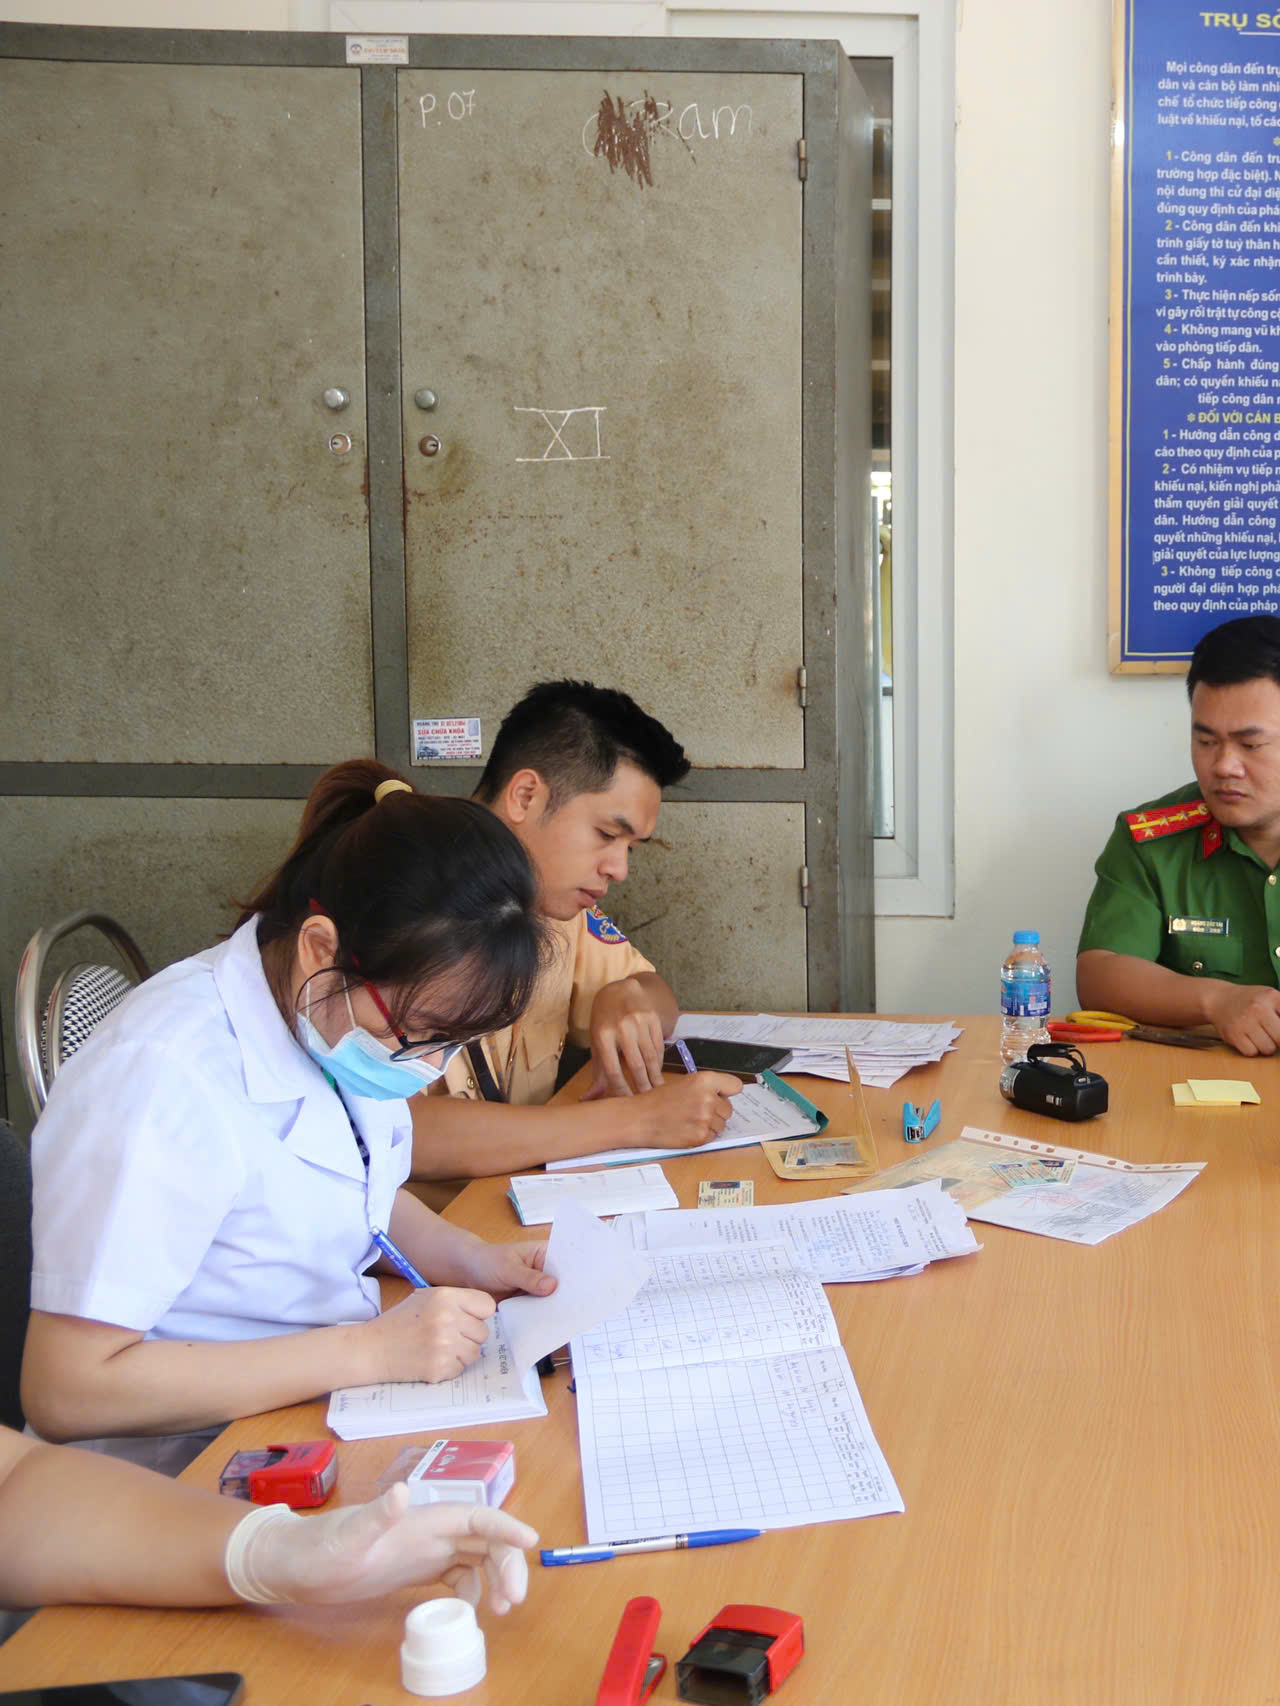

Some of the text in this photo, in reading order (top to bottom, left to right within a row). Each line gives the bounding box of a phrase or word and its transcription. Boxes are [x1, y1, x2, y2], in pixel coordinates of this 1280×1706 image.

[1200, 13, 1248, 31] TRỤ
[1166, 62, 1187, 75] Mọi
[1189, 62, 1218, 75] công
[1219, 62, 1241, 74] dân
[1243, 62, 1265, 75] đến
[1158, 78, 1179, 89] dân
[1221, 80, 1237, 93] bộ
[1195, 113, 1227, 125] khiếu
[1228, 115, 1249, 128] nại,
[1250, 114, 1263, 127] tố
[1156, 202, 1186, 216] đúng
[1187, 205, 1209, 216] quy
[1210, 203, 1236, 217] định
[1236, 202, 1258, 216] của
[1156, 253, 1177, 265] cần
[1181, 253, 1209, 267] thiết,
[1212, 255, 1226, 267] ký
[1230, 256, 1250, 266] xác
[1155, 375, 1180, 387] dân;
[1183, 375, 1198, 386] có
[1200, 374, 1235, 389] quyền
[1238, 375, 1269, 387] khiếu
[1198, 391, 1219, 406] tiếp
[1222, 393, 1250, 406] công
[1252, 393, 1274, 405] dân
[1198, 408, 1220, 423] ĐỐI
[1222, 410, 1243, 423] VỚI
[1245, 410, 1271, 424] CÁN
[1154, 495, 1183, 509] thẩm
[1185, 496, 1220, 511] quyền
[1223, 497, 1244, 512] giải
[1247, 496, 1279, 511] quyết
[1153, 514, 1178, 526] dân.
[1182, 514, 1220, 527] Hướng
[1223, 512, 1244, 526] dẫn
[1248, 515, 1276, 528] công
[1153, 583, 1186, 596] người
[1189, 582, 1207, 596] đại
[1209, 582, 1234, 596] diện
[1237, 582, 1260, 597] hợp
